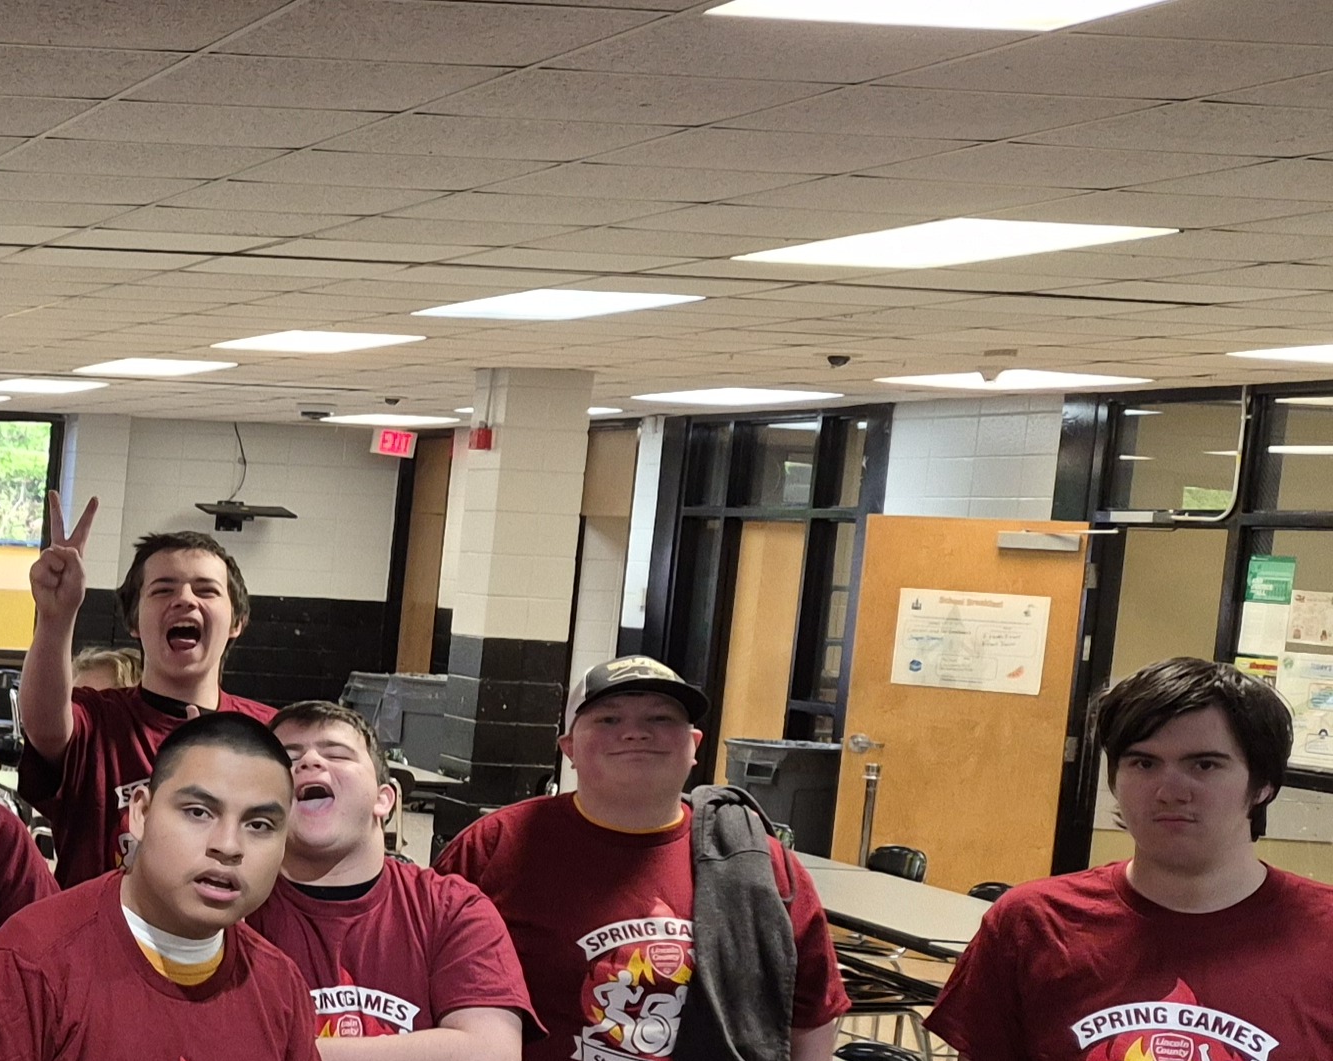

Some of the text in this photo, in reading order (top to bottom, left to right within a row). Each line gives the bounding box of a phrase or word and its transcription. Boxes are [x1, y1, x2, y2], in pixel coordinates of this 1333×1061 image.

[585, 921, 657, 952] SPRING
[1080, 1006, 1266, 1053] SPRING GAMES
[1155, 1038, 1190, 1048] Lincoln
[1155, 1047, 1189, 1057] County
